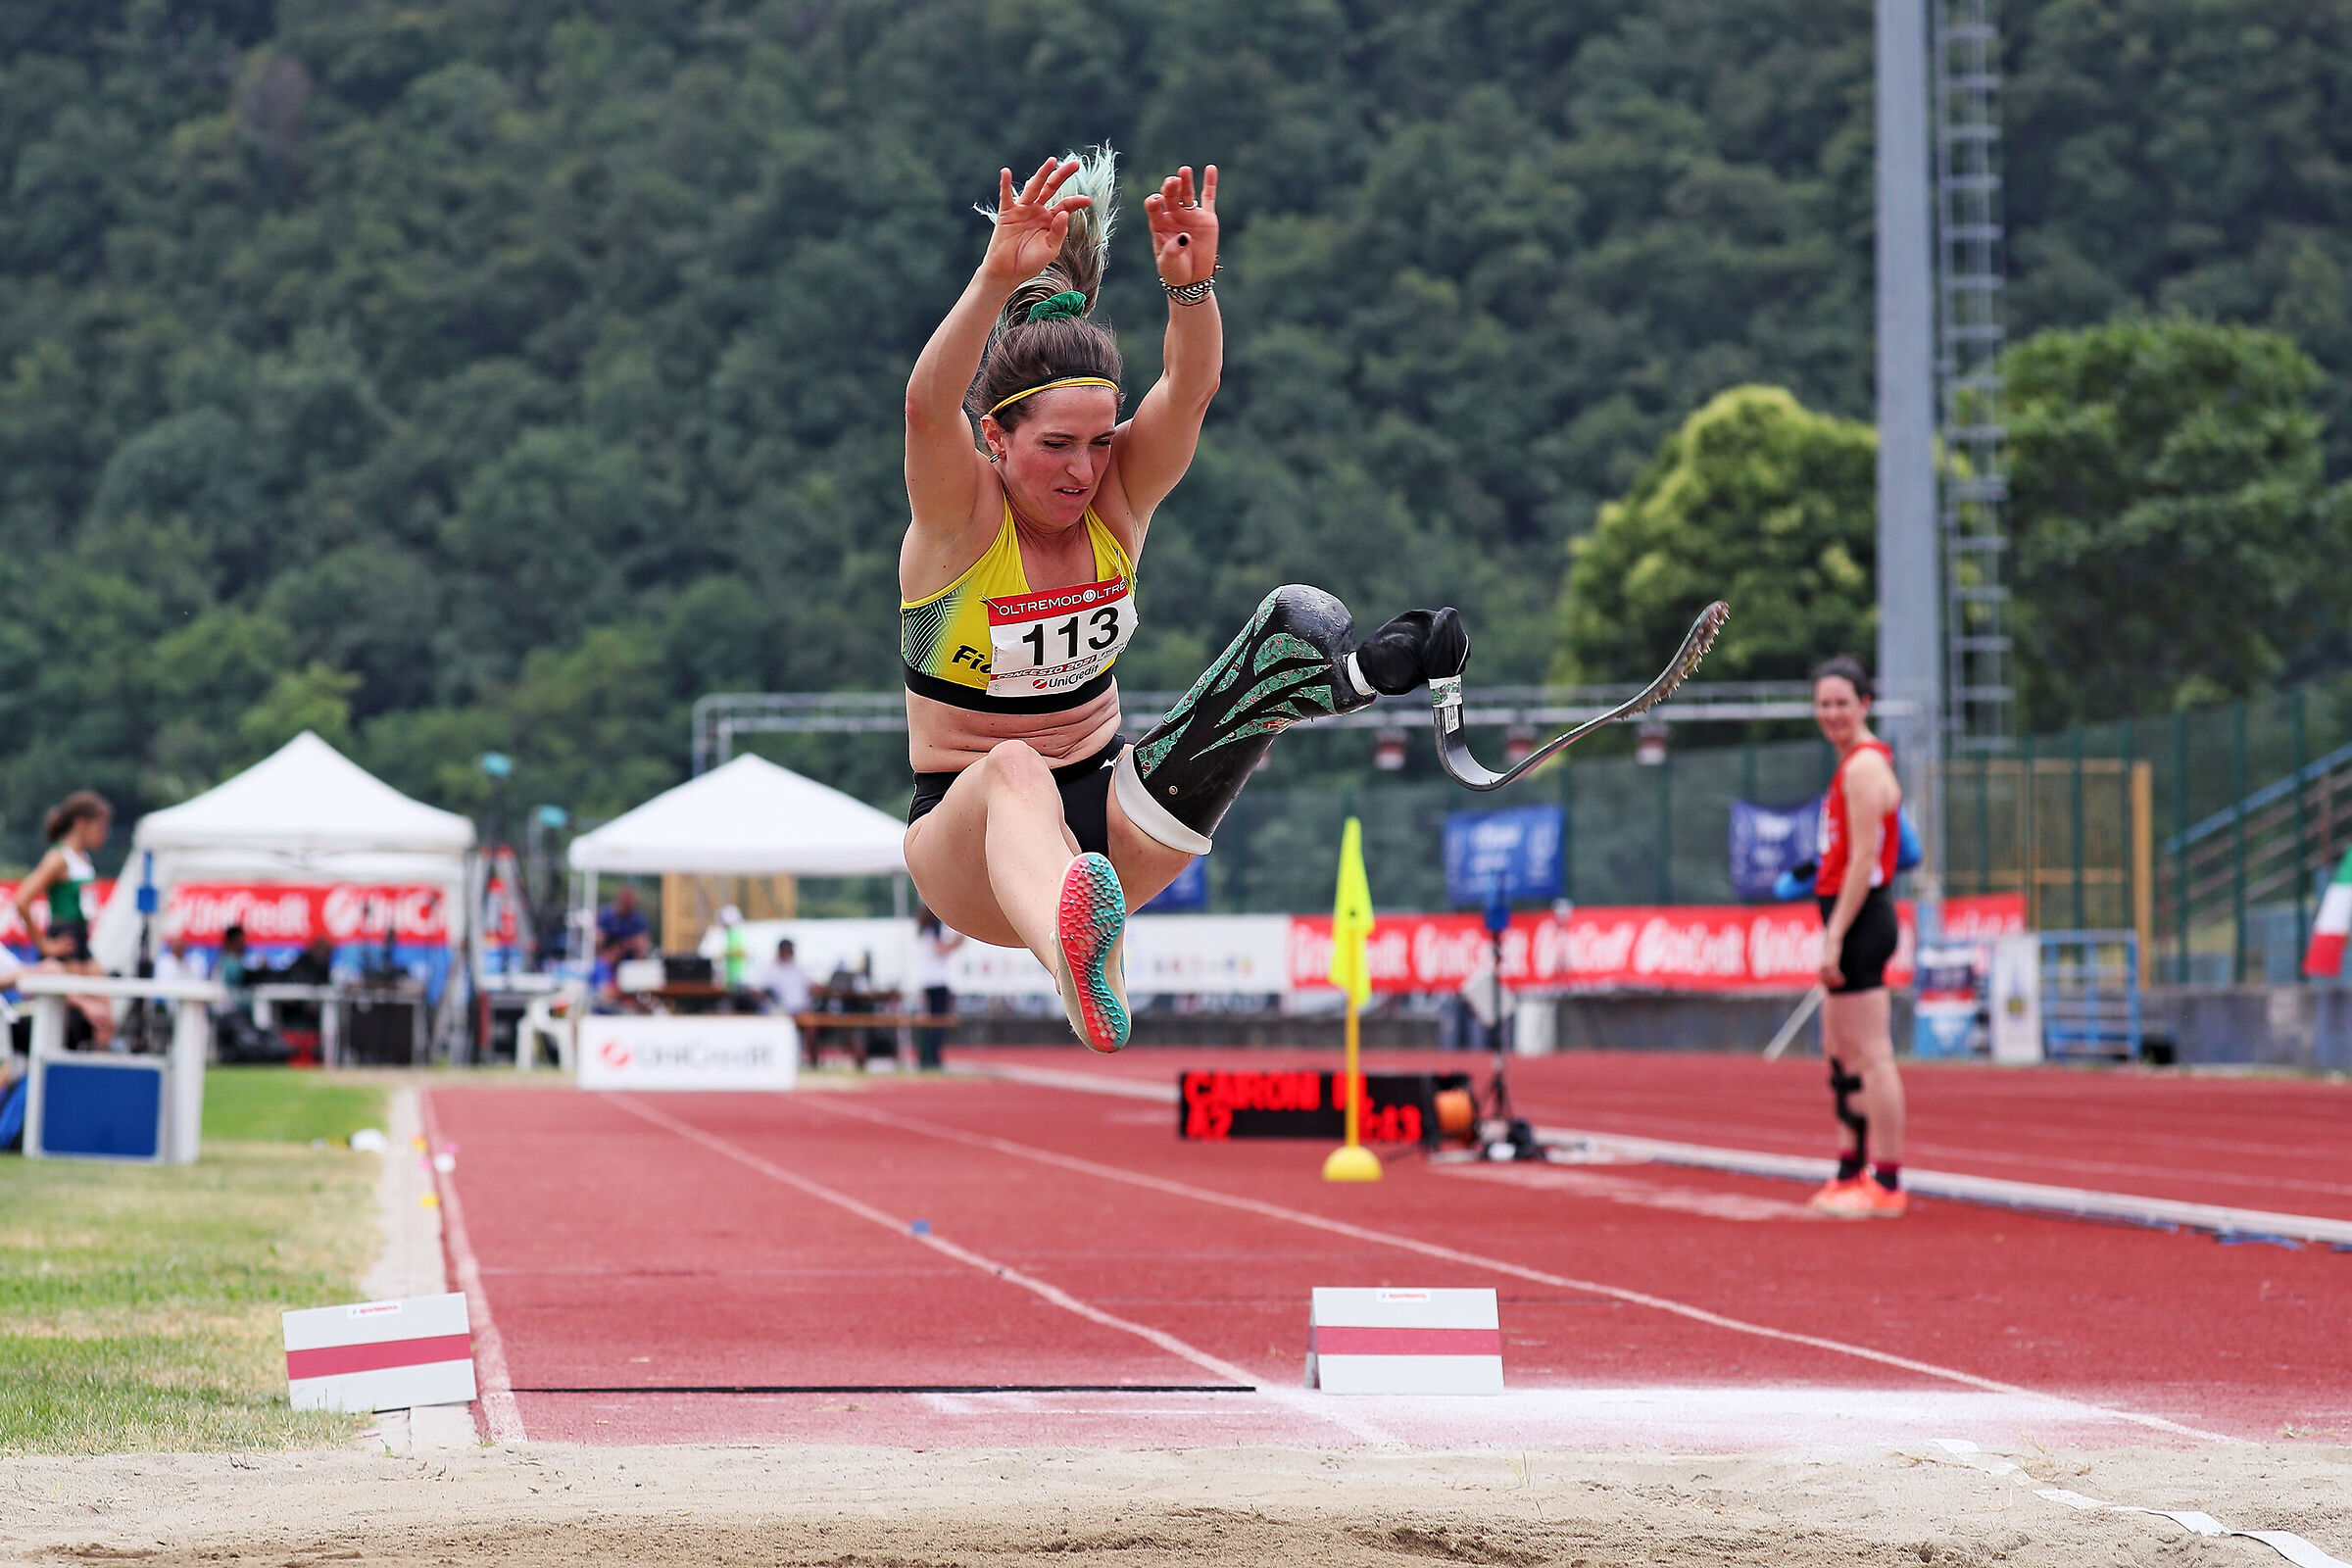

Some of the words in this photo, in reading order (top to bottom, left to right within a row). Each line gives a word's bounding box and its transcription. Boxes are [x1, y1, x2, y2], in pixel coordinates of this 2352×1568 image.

[1022, 606, 1119, 666] 113
[1049, 663, 1099, 688] UniCredit
[637, 1041, 773, 1070] UniCredit
